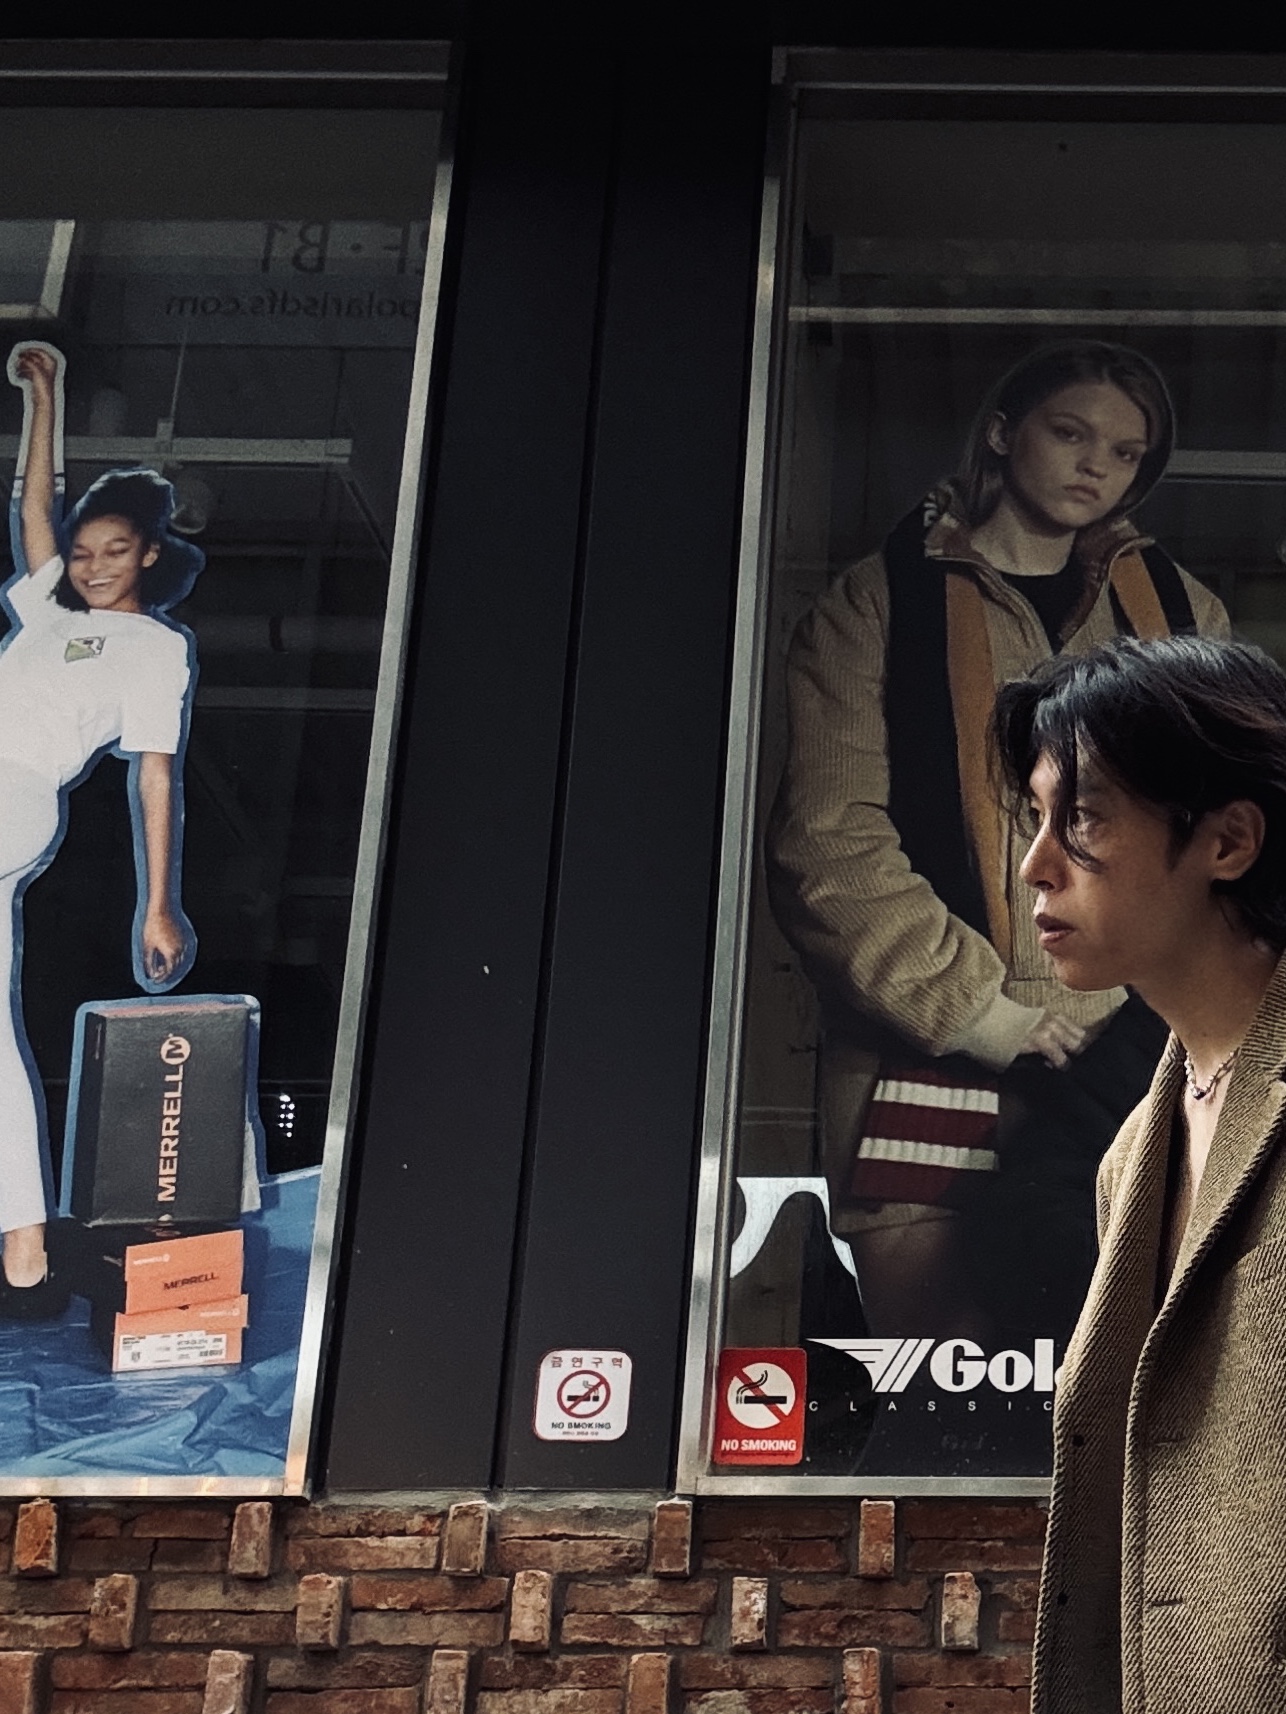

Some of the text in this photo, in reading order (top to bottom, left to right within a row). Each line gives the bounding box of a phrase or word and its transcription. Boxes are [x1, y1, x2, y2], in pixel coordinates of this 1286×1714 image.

[157, 1065, 184, 1202] MERRELL
[163, 1272, 218, 1290] MERRELL
[568, 1422, 612, 1430] SMOKING
[721, 1439, 797, 1451] NO SMOKING
